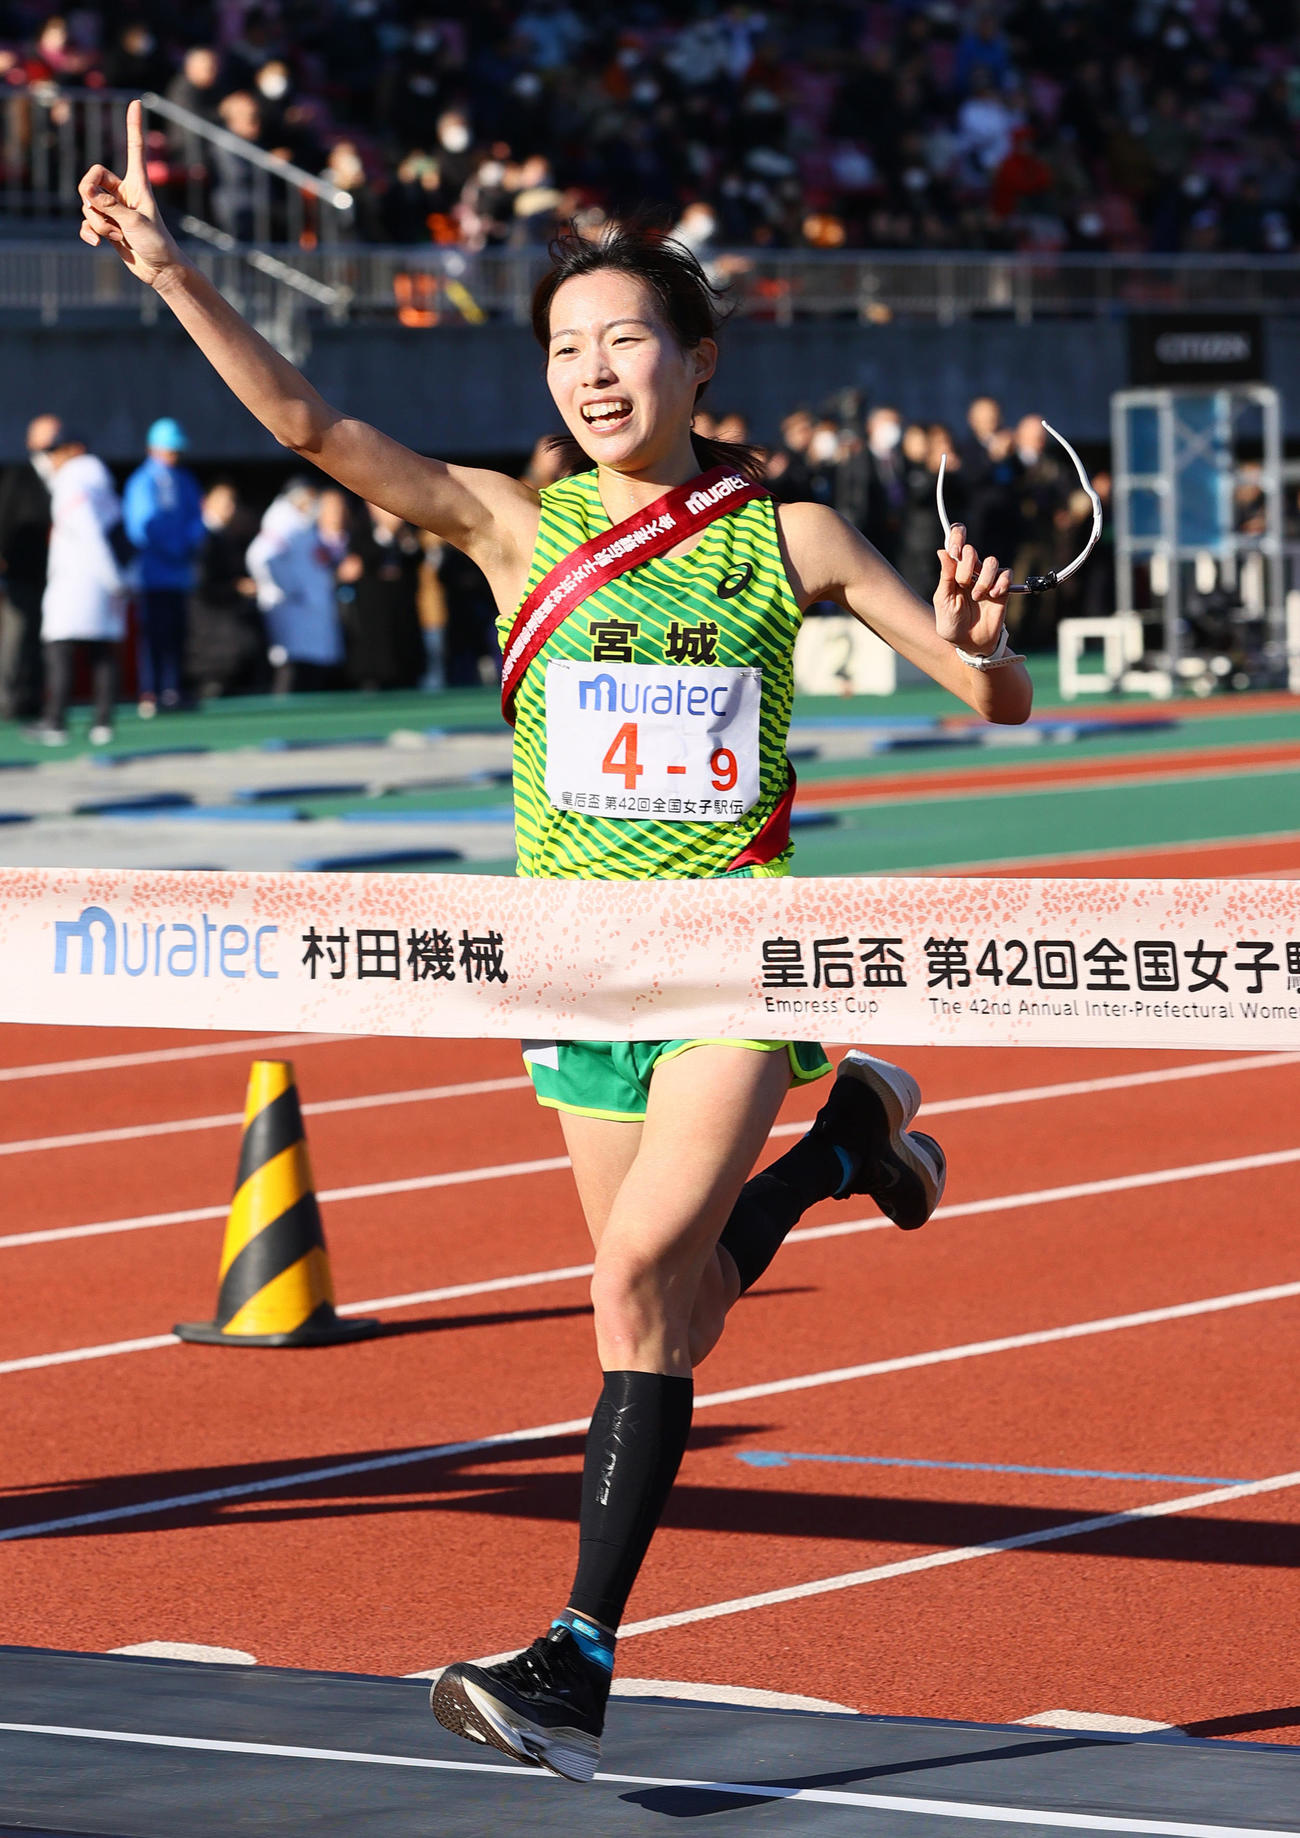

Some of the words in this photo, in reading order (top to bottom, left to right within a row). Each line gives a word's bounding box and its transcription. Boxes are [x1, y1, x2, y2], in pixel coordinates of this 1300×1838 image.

[684, 474, 750, 515] muratec
[589, 618, 719, 664] 宮城
[579, 673, 728, 716] muratec
[561, 791, 600, 809] 皇后盃
[605, 795, 744, 815] 第42回全国女子駅伝
[53, 906, 279, 979] muratec
[301, 925, 509, 984] 村田機械
[761, 936, 907, 988] 皇后盃
[924, 937, 1300, 994] 第42回全国女子
[765, 996, 838, 1015] Empress
[845, 996, 879, 1016] Cup
[929, 998, 962, 1013] The
[969, 998, 1011, 1015] 42nd
[1019, 1000, 1079, 1016] Annual
[1086, 1001, 1235, 1018] Inter-Prefectural
[1240, 1002, 1300, 1019] Wome
